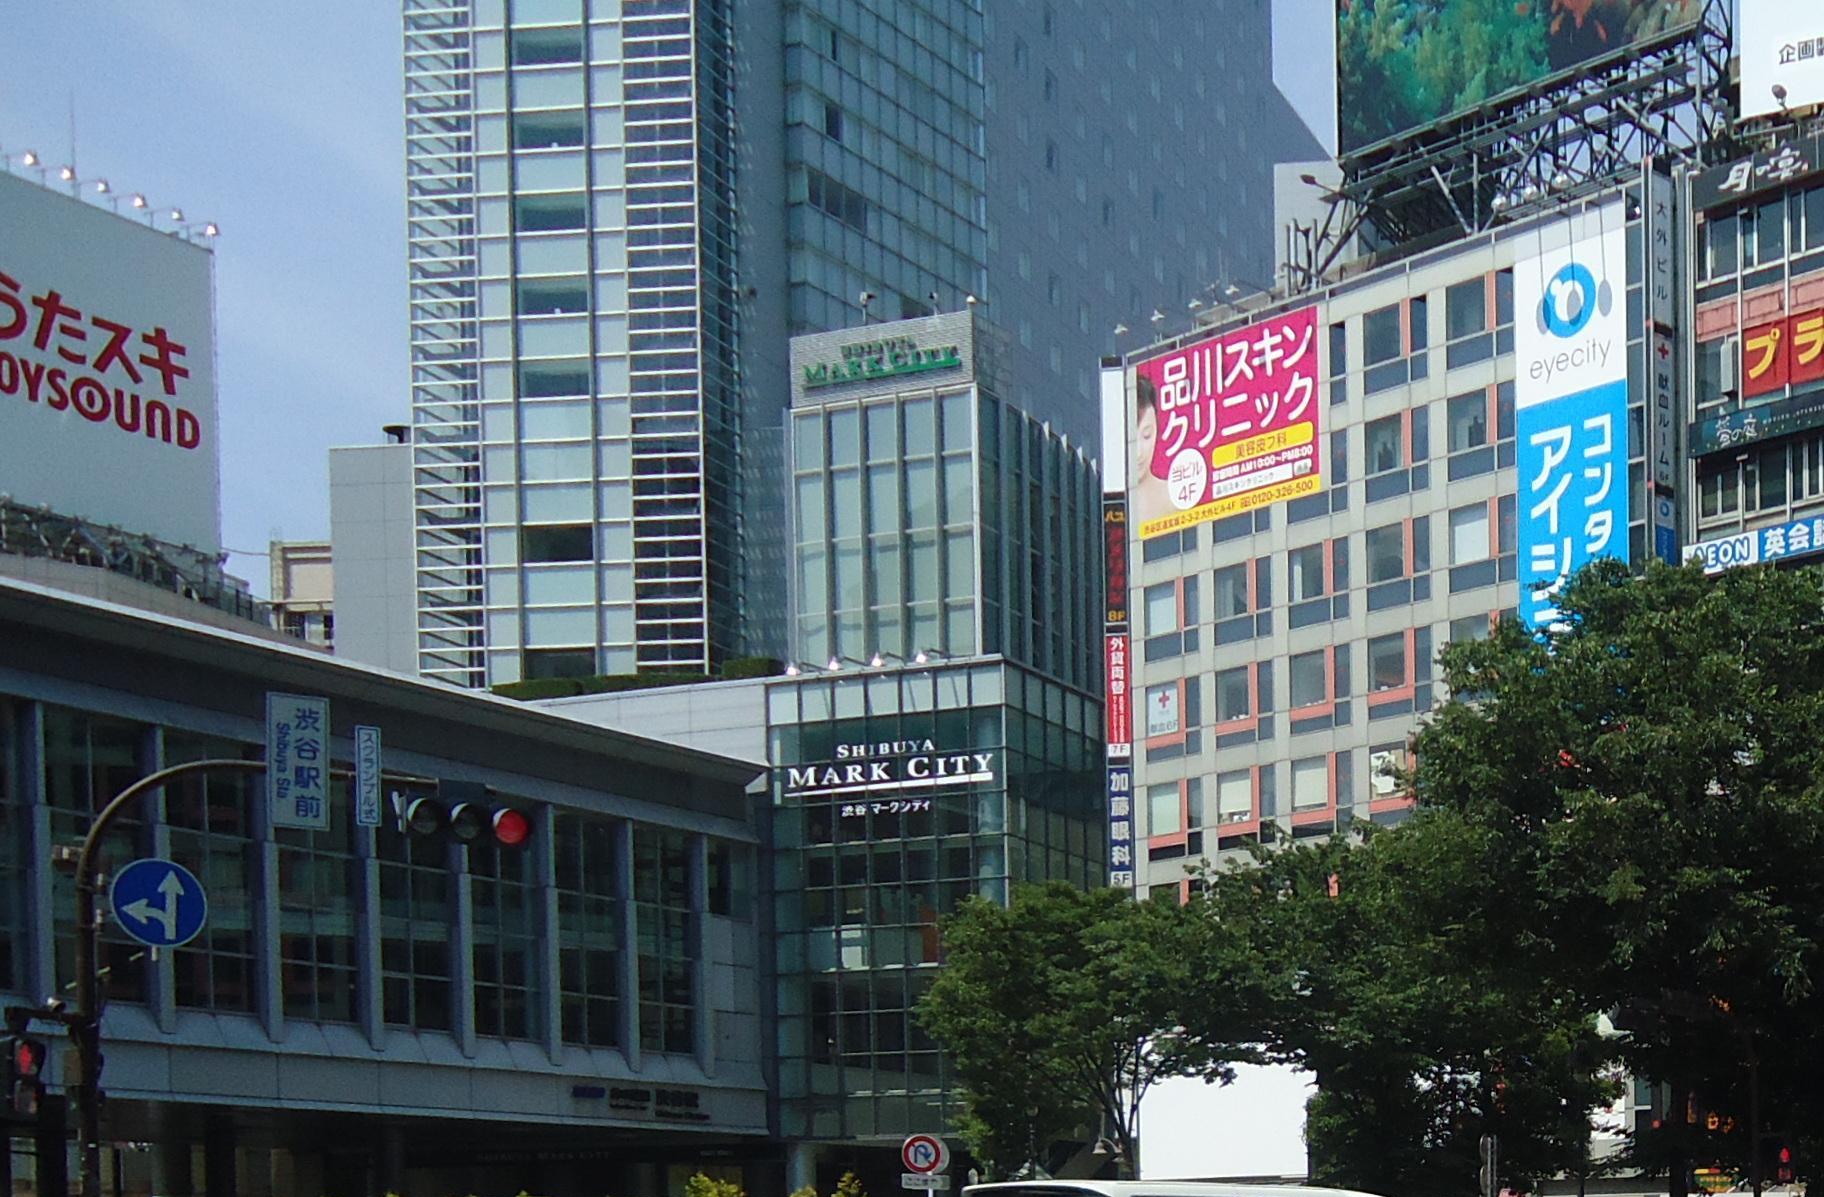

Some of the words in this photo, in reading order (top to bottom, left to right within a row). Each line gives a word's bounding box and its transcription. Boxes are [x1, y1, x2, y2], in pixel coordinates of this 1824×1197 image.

[1656, 202, 1668, 301] 大外ビル
[1160, 325, 1313, 411] 品川スキン
[1529, 338, 1612, 385] eyecity
[1162, 371, 1313, 457] クリニック
[1172, 461, 1203, 483] 当ビル
[1178, 482, 1198, 503] 4F
[274, 721, 291, 773] Shibuya
[294, 707, 321, 819] 渋谷駅前
[836, 738, 936, 759] SHIBUYA
[1110, 745, 1126, 755] 7F
[276, 777, 291, 799] Sta
[362, 732, 377, 821] スクランブル式
[787, 761, 891, 788] MARK
[907, 753, 994, 778] CITY
[870, 799, 931, 815] マークシティ
[1110, 772, 1131, 866] 加藤眼科
[1113, 873, 1130, 885] 5F
